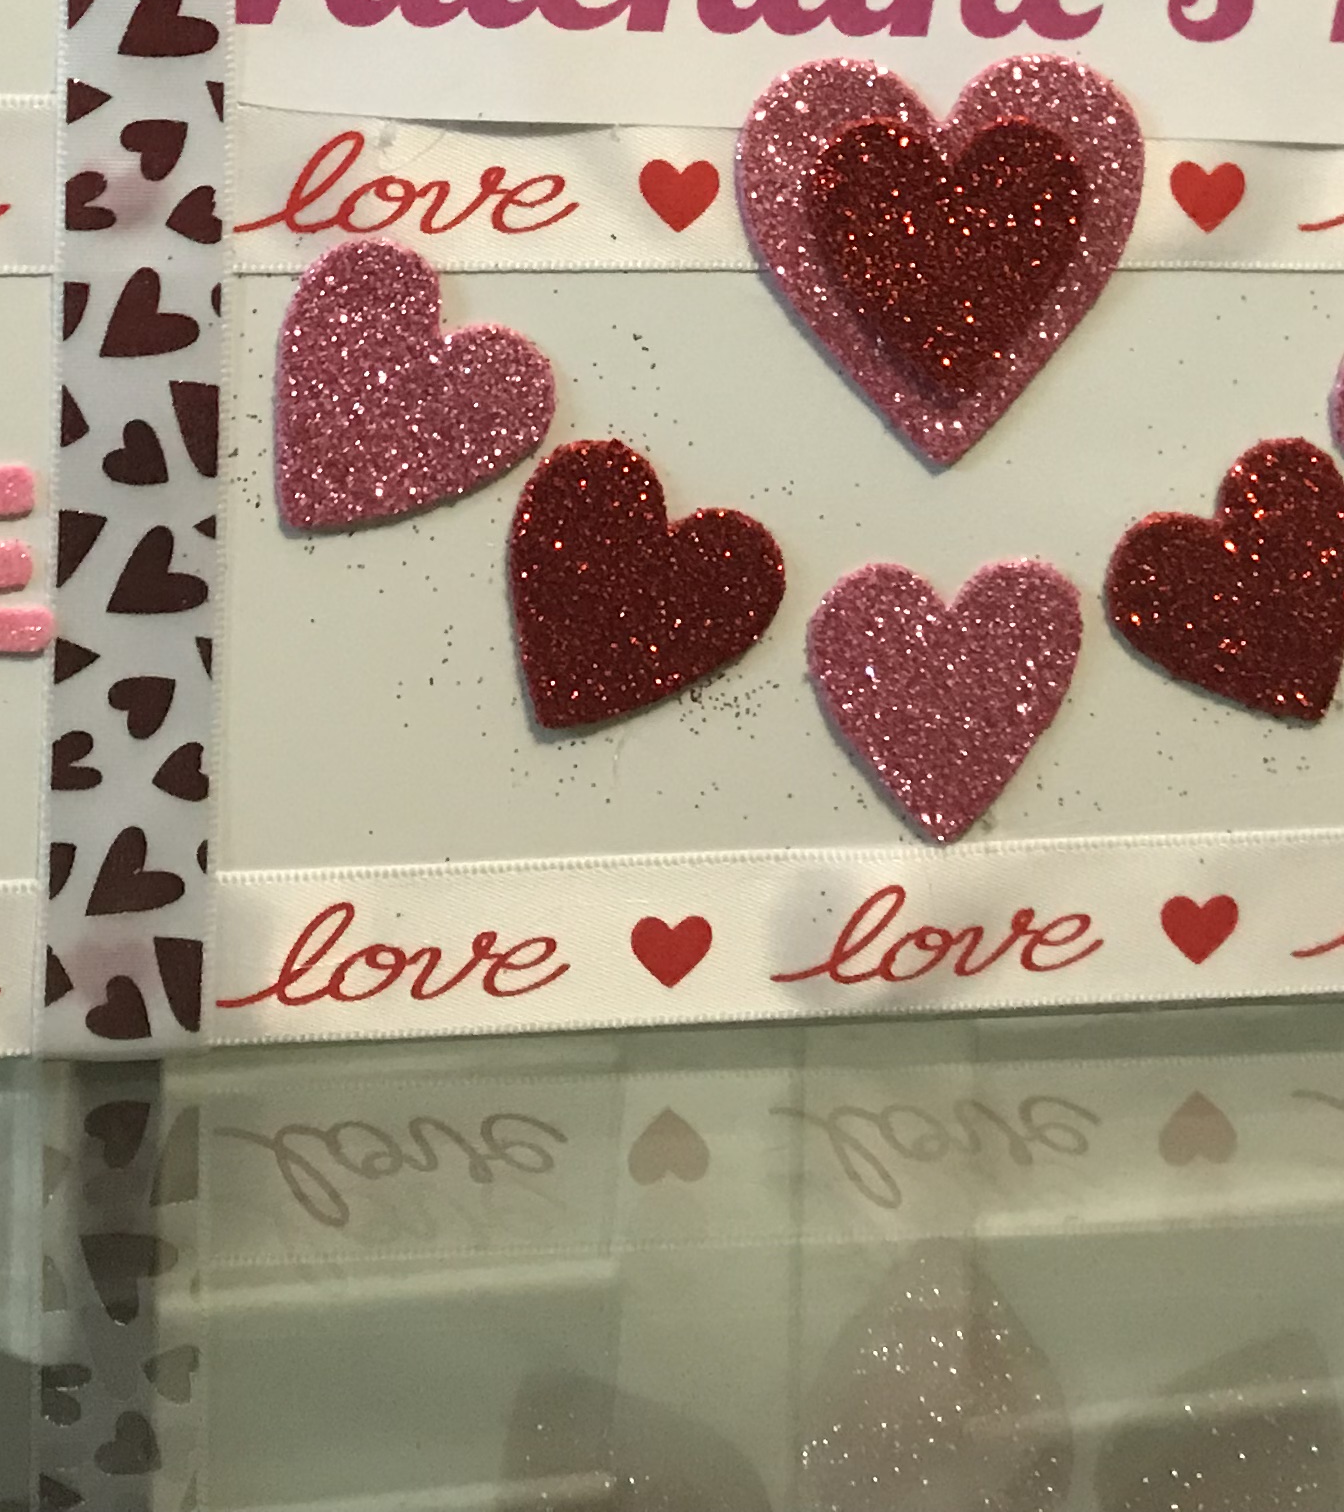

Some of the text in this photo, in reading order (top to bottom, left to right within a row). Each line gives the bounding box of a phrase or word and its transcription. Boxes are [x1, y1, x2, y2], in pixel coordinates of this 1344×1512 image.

[233, 130, 580, 235] love
[216, 902, 569, 1009] love
[772, 885, 1103, 984] love
